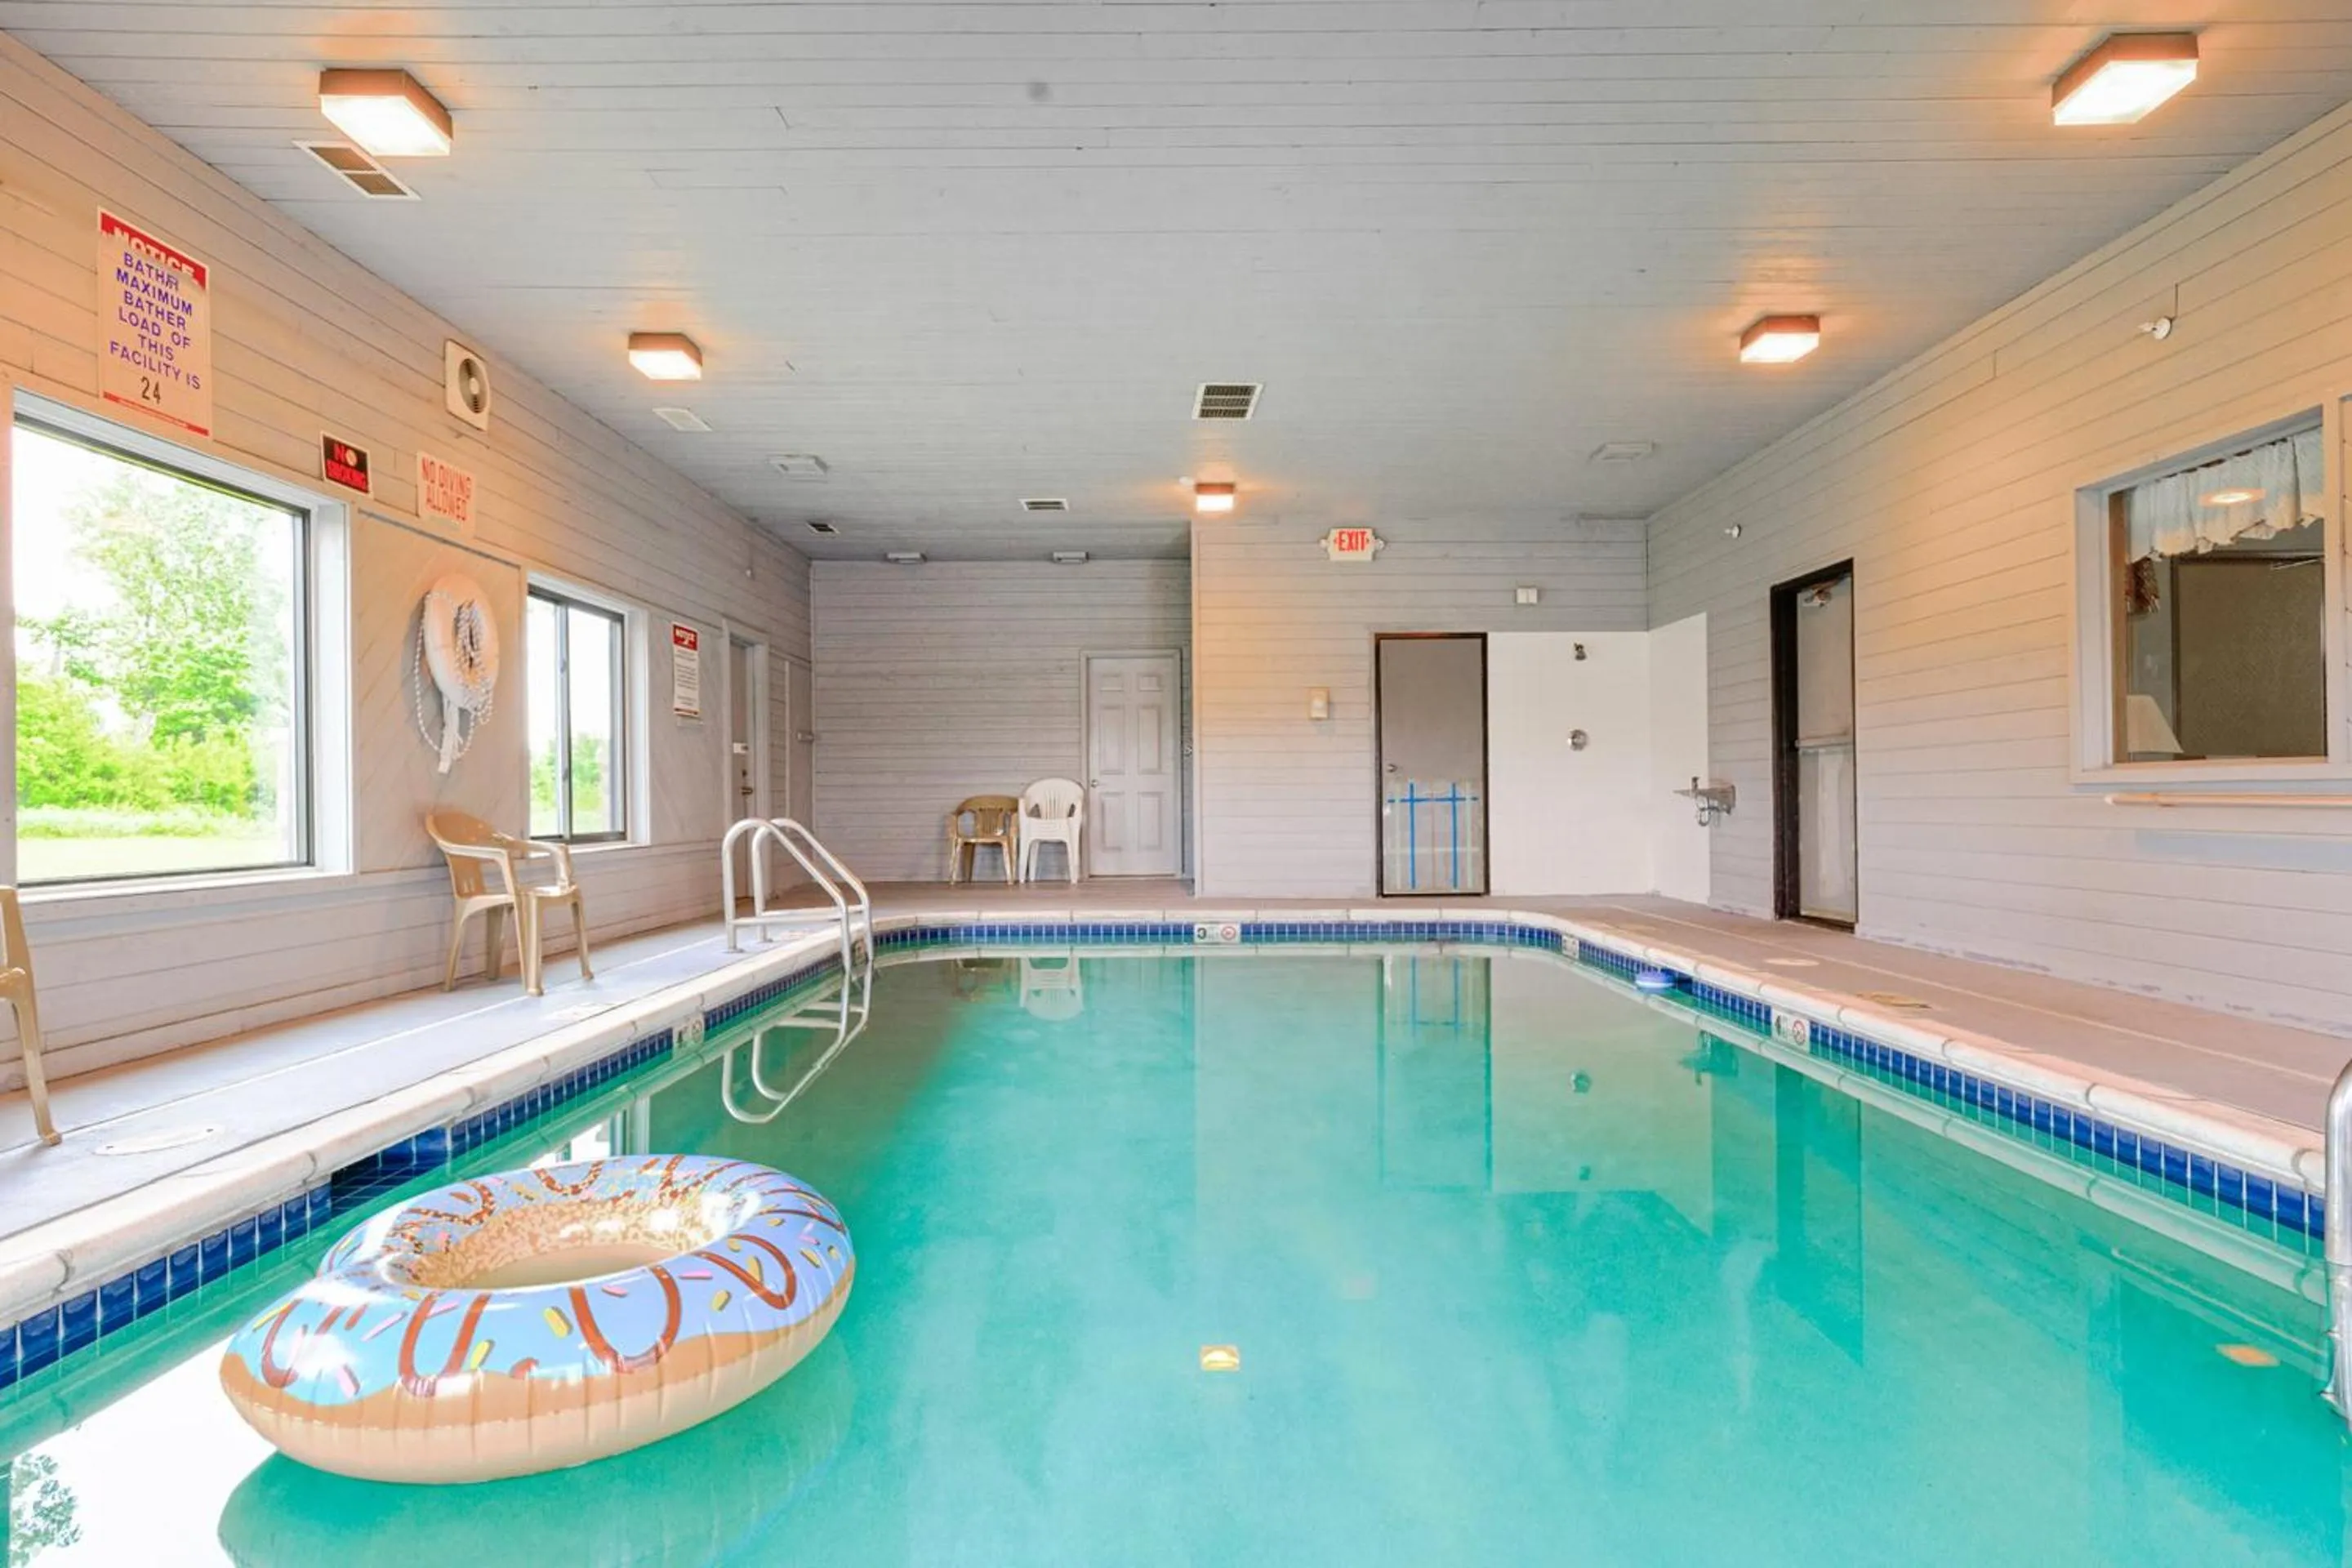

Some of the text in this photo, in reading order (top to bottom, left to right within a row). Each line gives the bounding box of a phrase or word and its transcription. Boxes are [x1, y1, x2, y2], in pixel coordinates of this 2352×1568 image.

[116, 267, 193, 317] MAXIMUM
[124, 290, 186, 330] BATHER
[118, 306, 191, 350] LOAD OF
[138, 333, 175, 362] THIS
[109, 341, 202, 390] FACILITY IS
[140, 376, 162, 405] 24
[421, 457, 471, 501] NO DIVING
[425, 483, 468, 522] ALLOWED
[1338, 530, 1368, 552] EXIT
